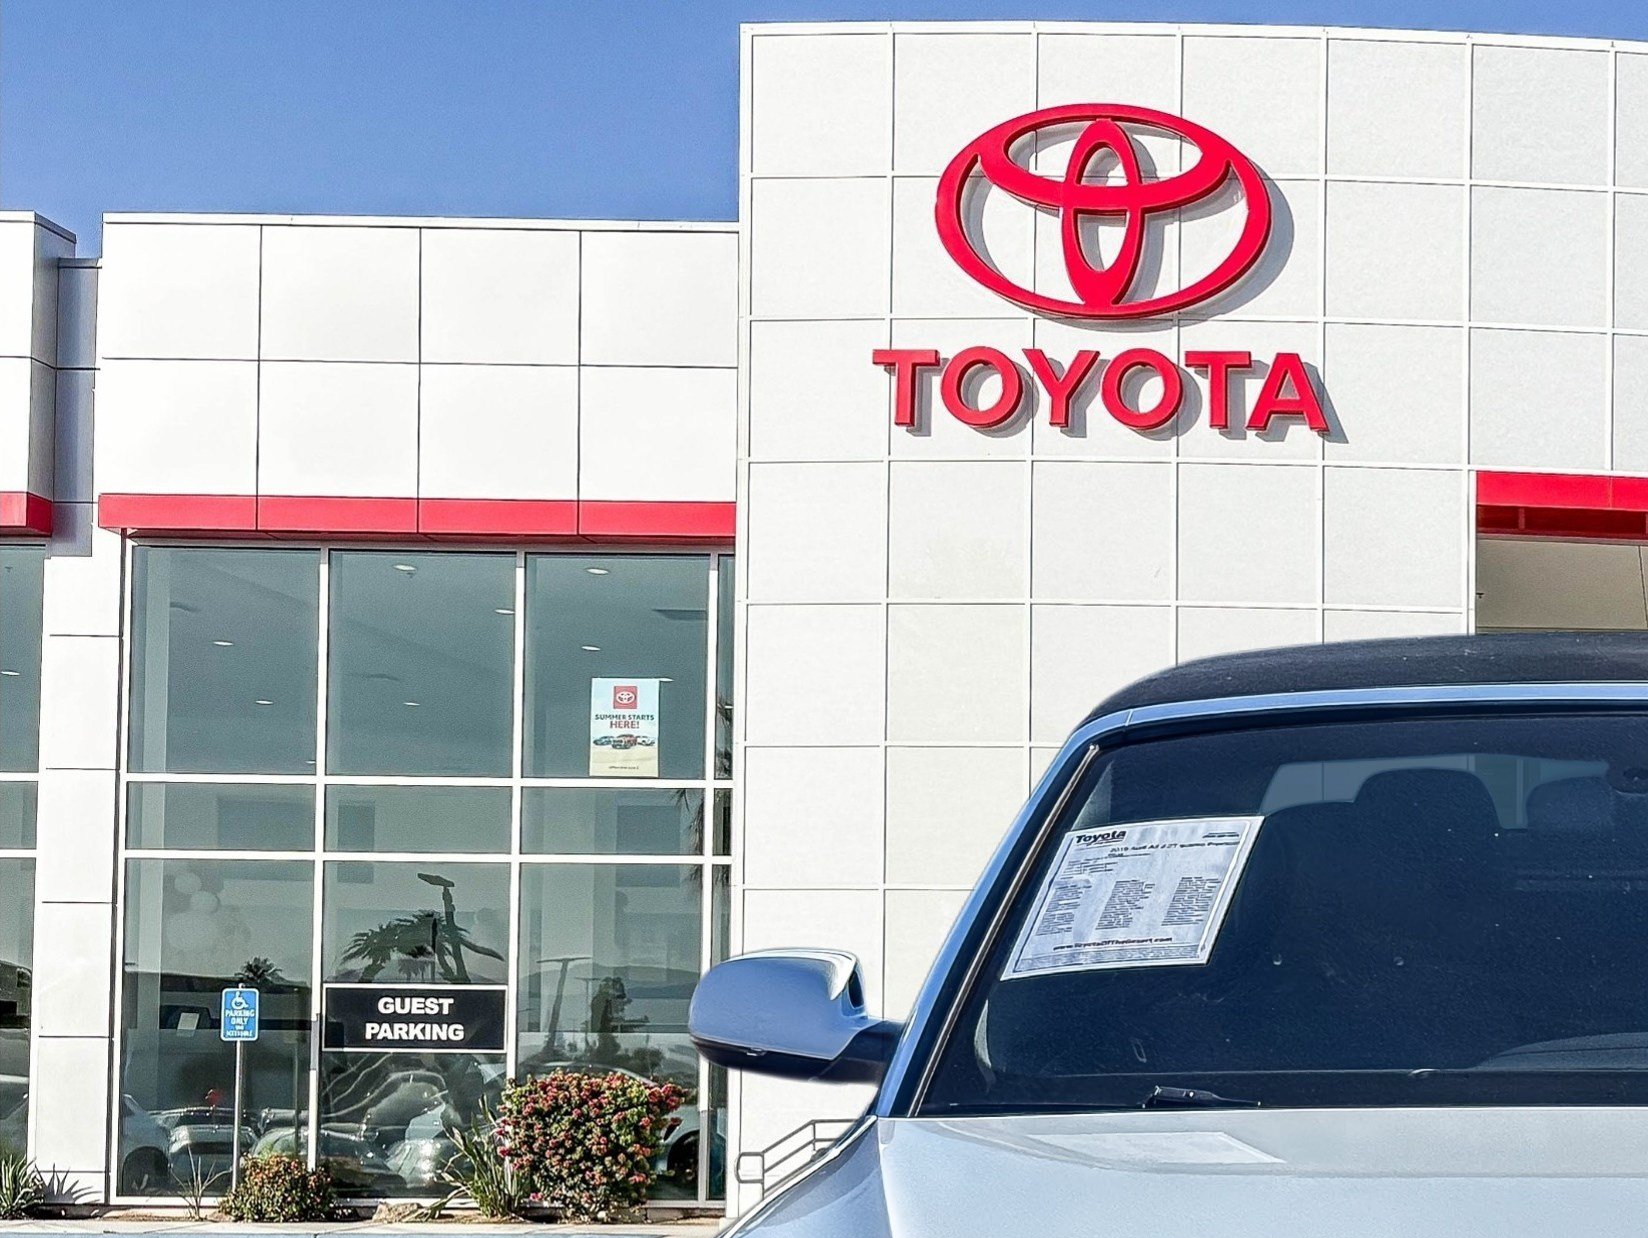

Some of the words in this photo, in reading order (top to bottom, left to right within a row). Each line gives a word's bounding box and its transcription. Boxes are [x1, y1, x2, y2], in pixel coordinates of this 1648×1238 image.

[872, 346, 1330, 433] TOYOTA
[609, 720, 640, 729] HERE!
[1075, 830, 1127, 846] Toyota
[225, 1009, 255, 1018] PARKING
[377, 996, 454, 1015] GUEST
[365, 1022, 465, 1041] PARKING
